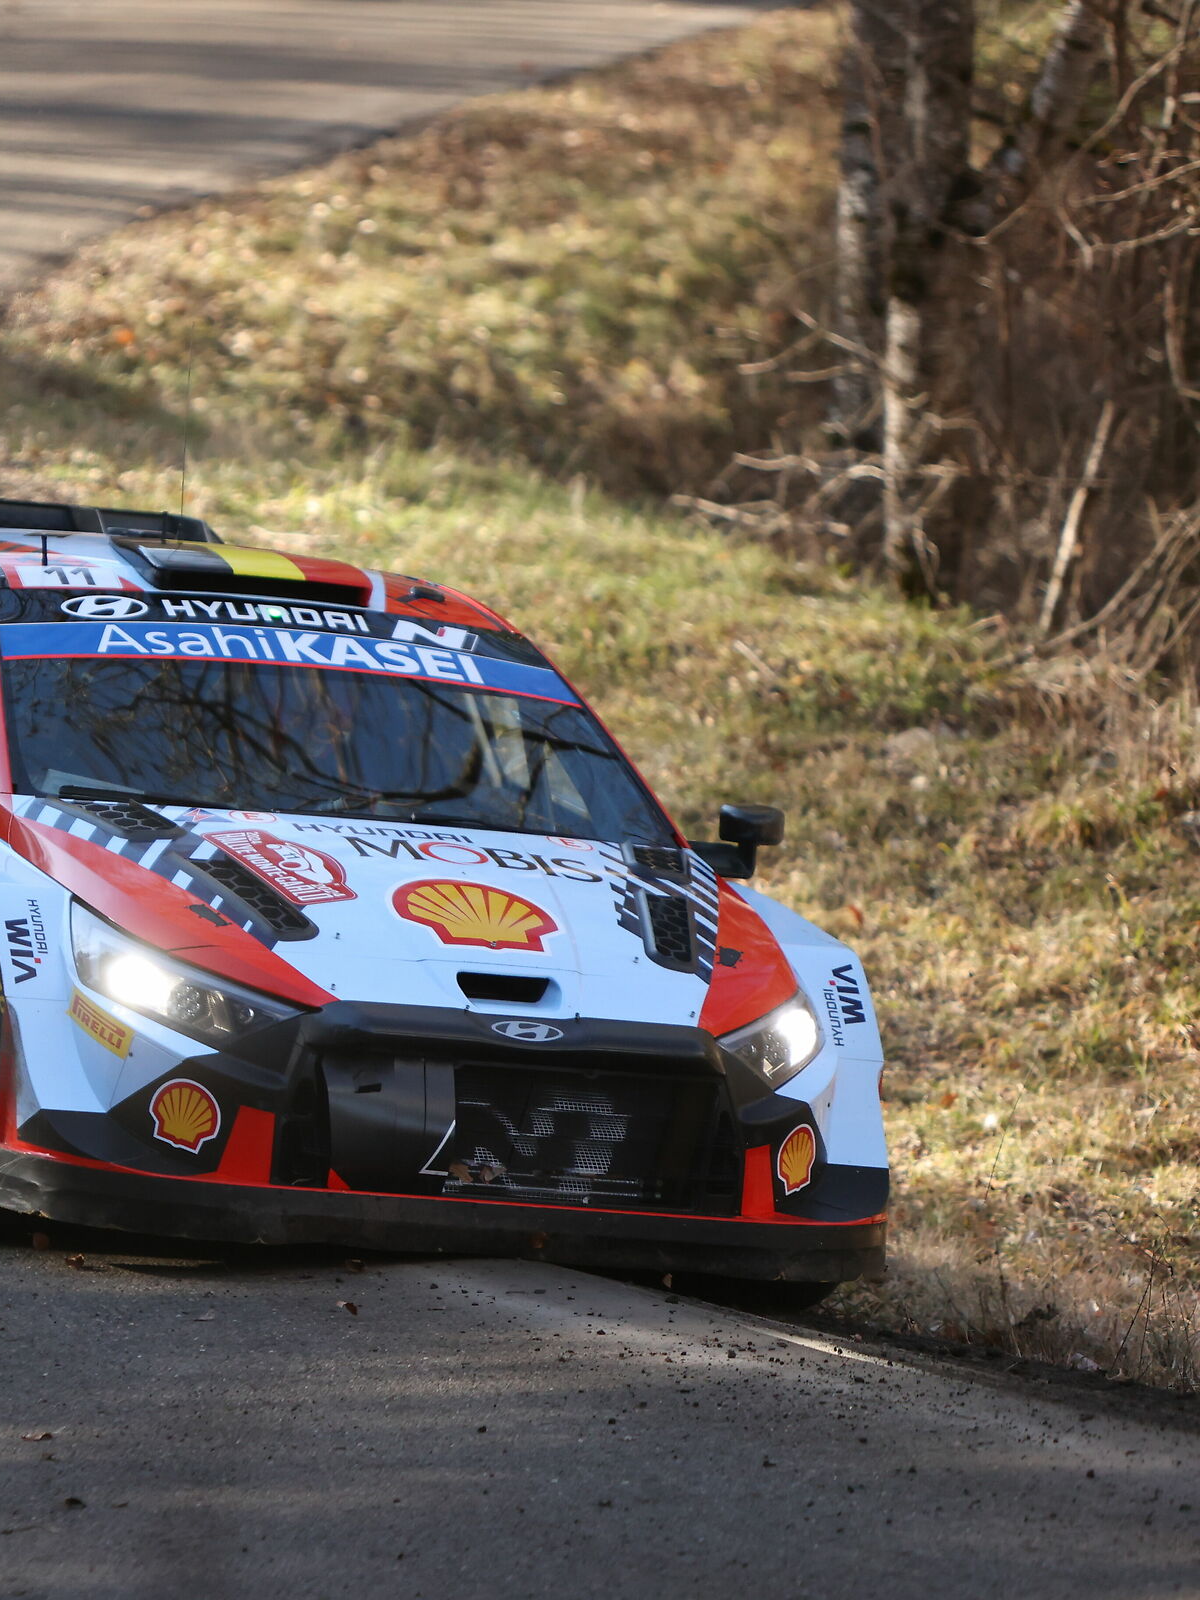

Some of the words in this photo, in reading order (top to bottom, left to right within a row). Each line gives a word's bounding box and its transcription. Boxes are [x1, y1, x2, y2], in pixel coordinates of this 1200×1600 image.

[43, 565, 96, 588] 11
[162, 598, 370, 633] HYUNDAI
[391, 619, 479, 652] N
[241, 812, 265, 821] E
[292, 822, 473, 844] HYUNDAI
[343, 835, 604, 883] MOBIS
[4, 918, 37, 984] WIA
[26, 899, 48, 954] HYUNDAI
[823, 989, 845, 1047] HYUNDAI
[831, 964, 867, 1025] WIA
[71, 994, 126, 1050] PIRELLI
